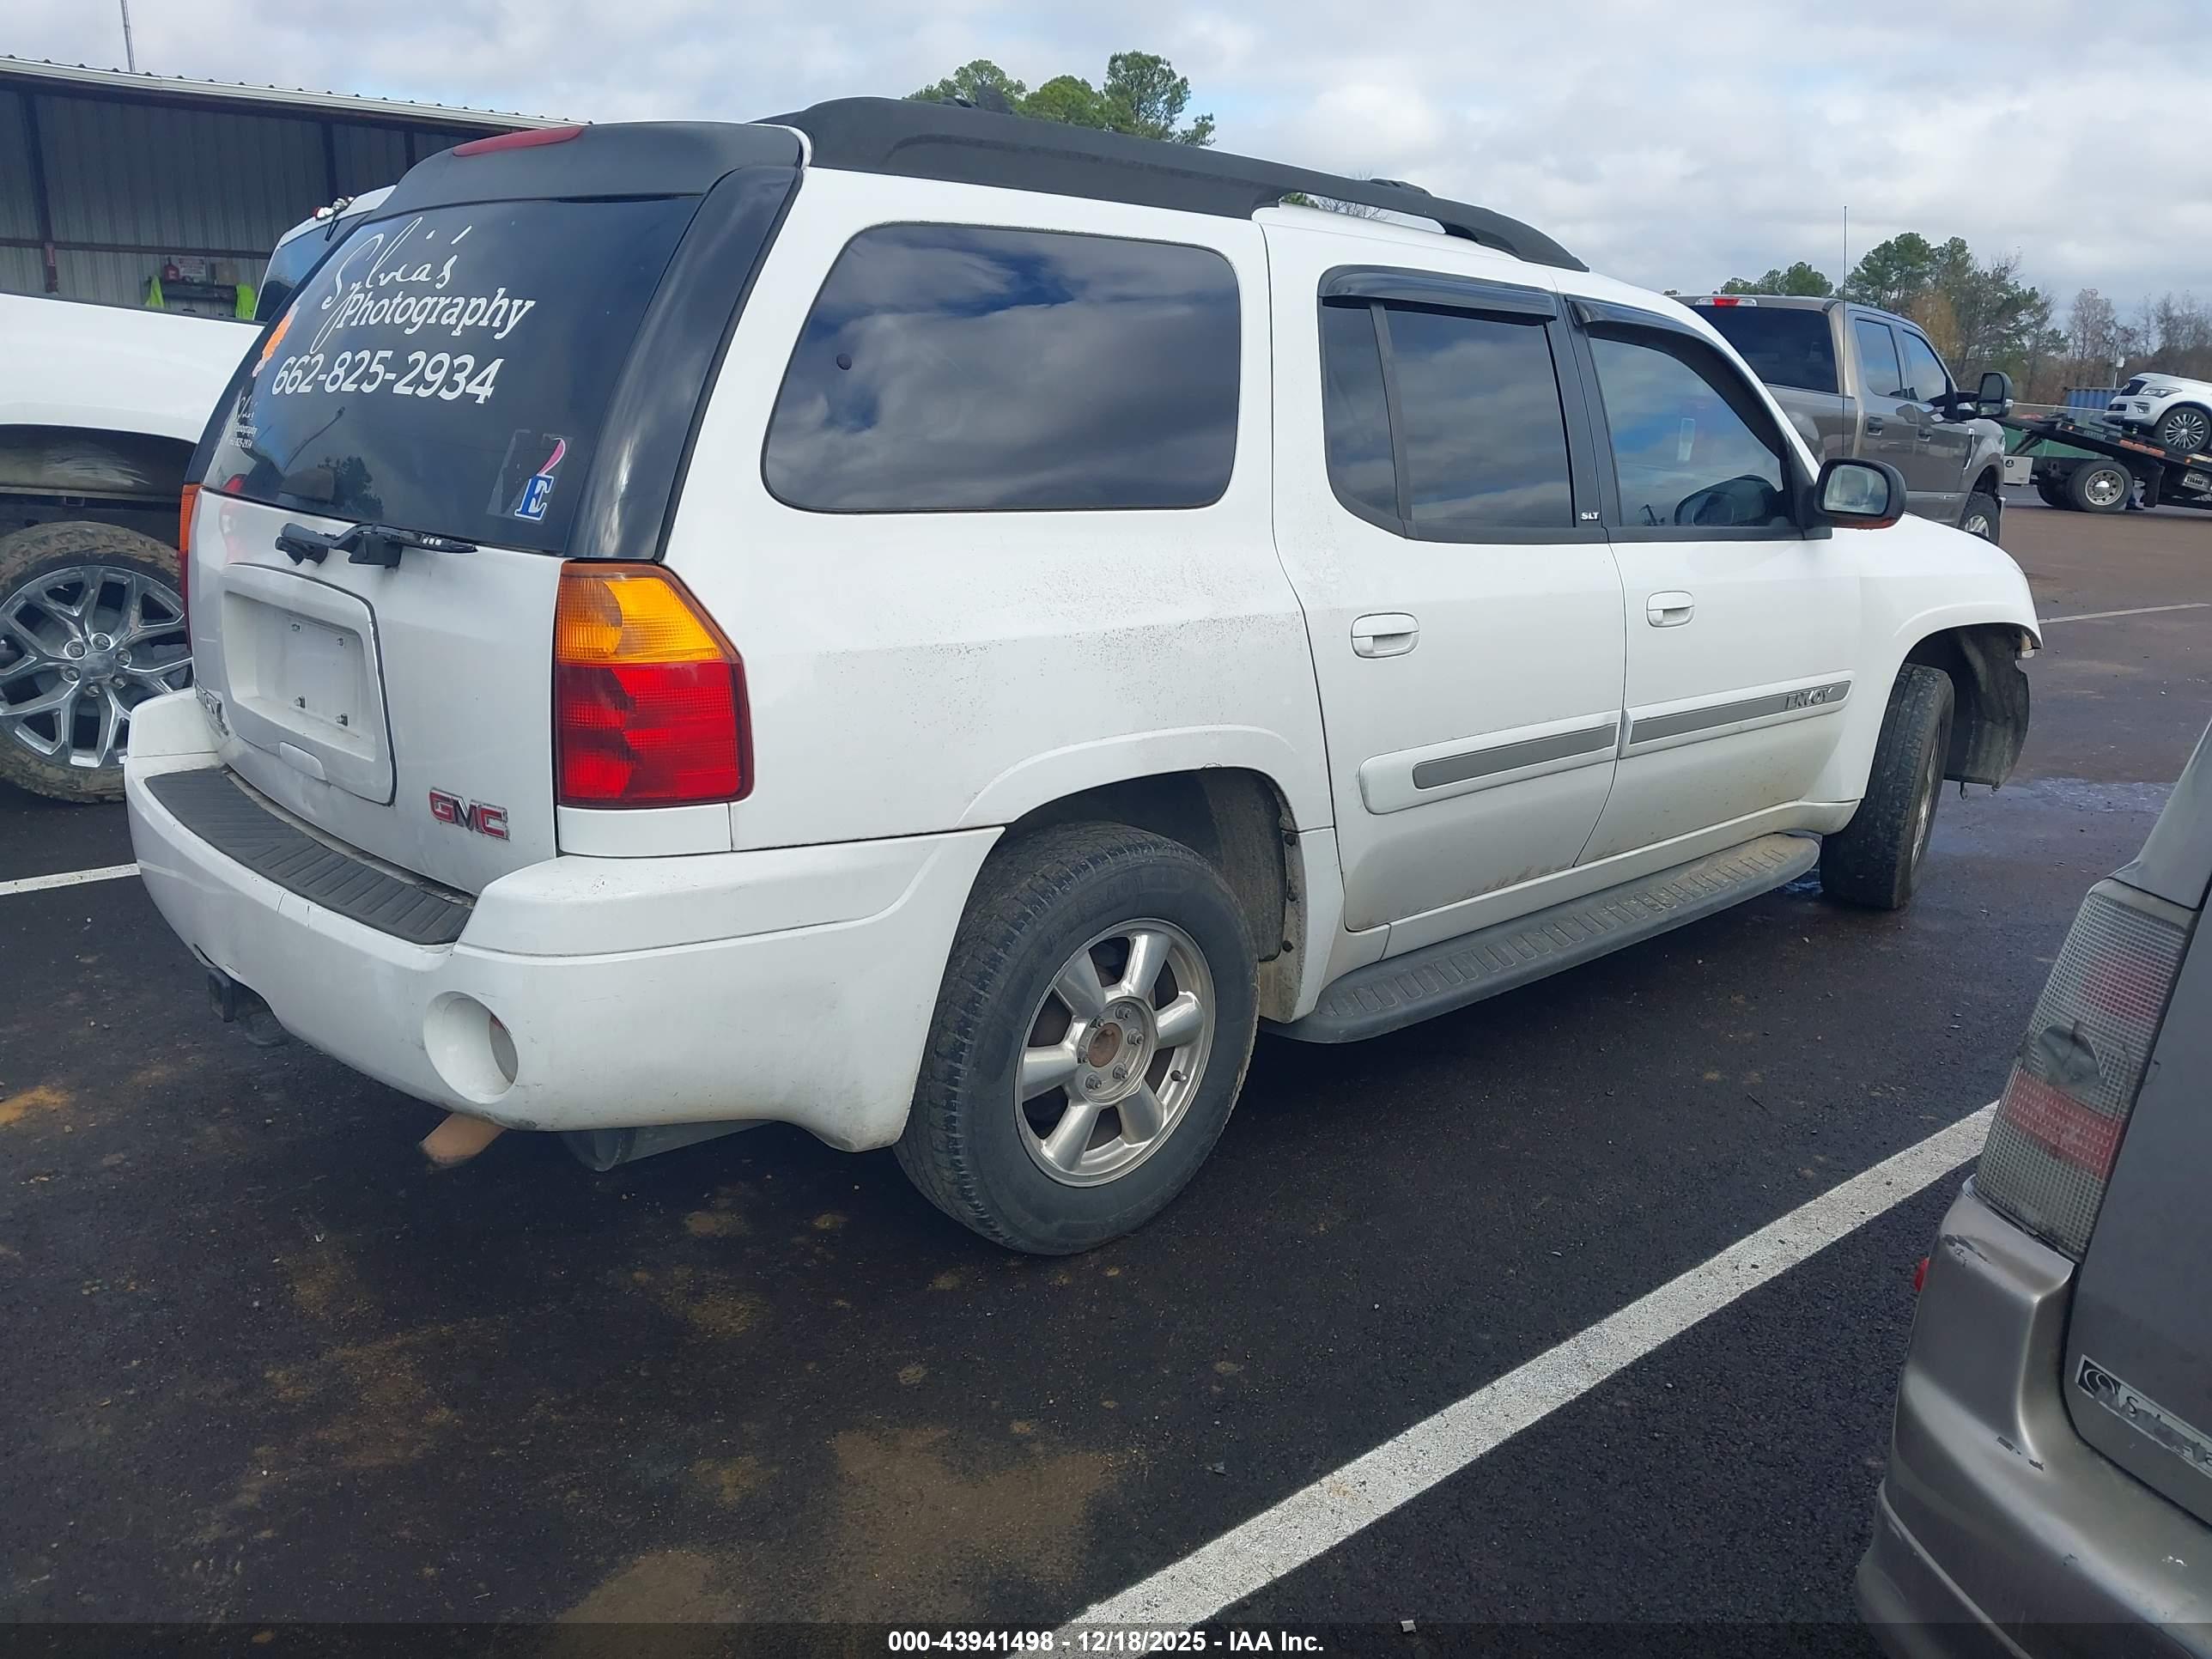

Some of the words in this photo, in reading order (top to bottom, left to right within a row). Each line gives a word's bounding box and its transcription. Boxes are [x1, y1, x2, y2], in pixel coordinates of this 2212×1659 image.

[336, 288, 536, 339] Photography
[271, 349, 505, 404] 662-825-2934
[1581, 511, 1600, 520] SLT
[428, 787, 511, 842] GMC
